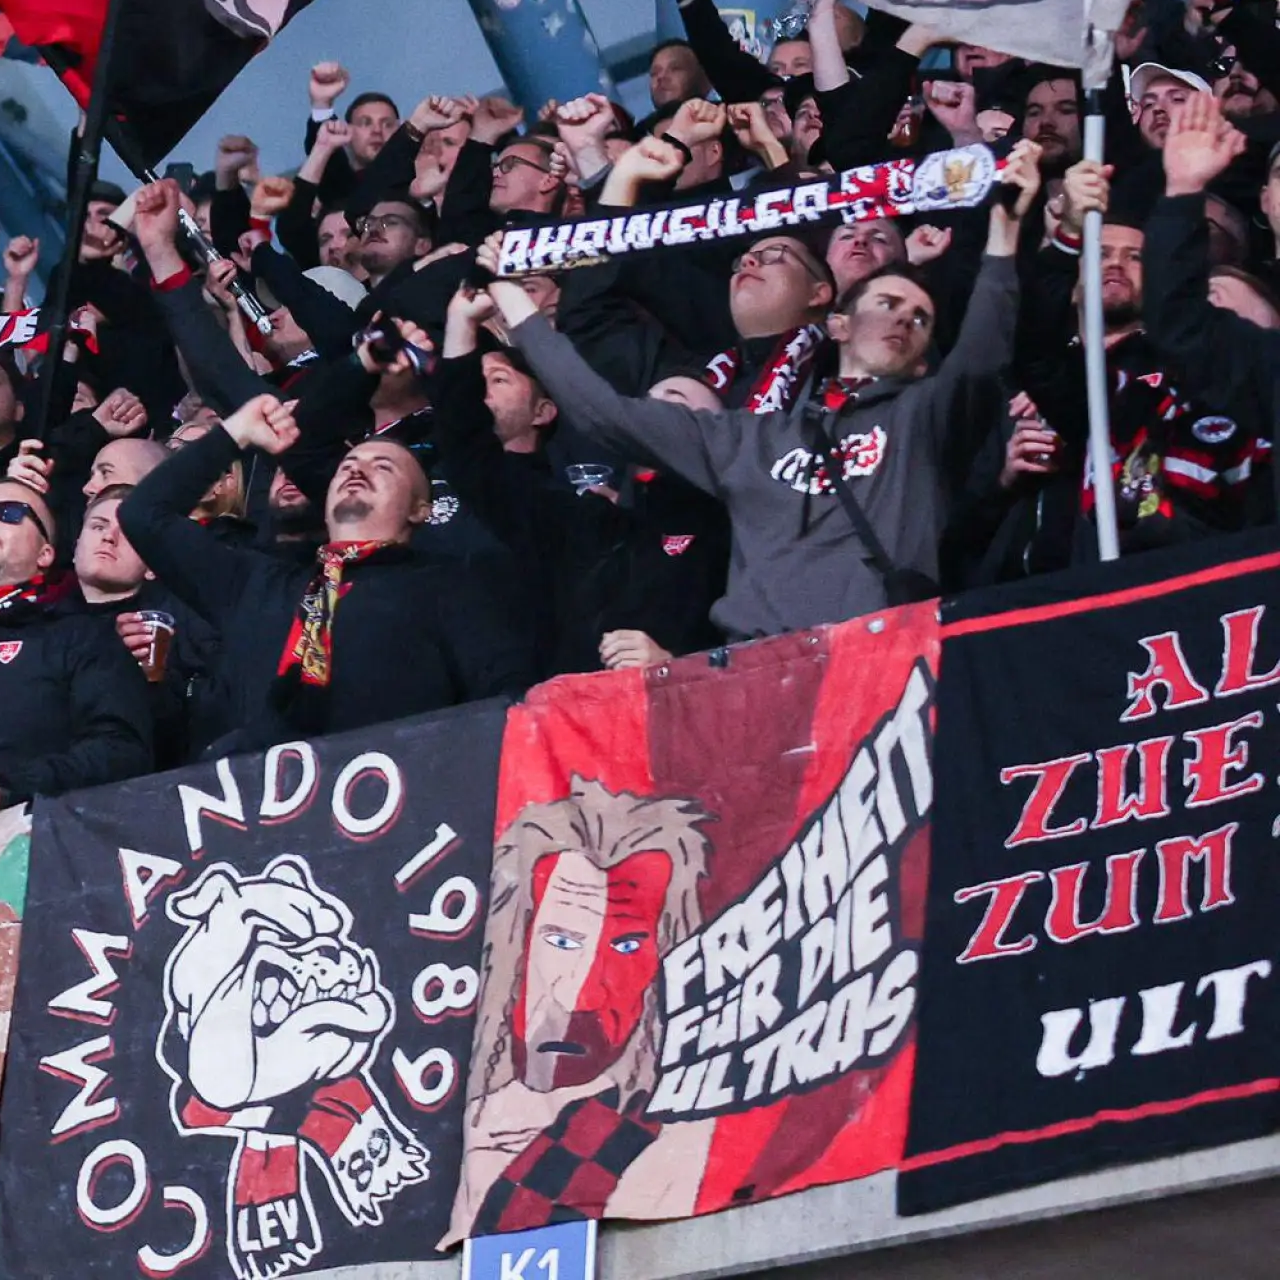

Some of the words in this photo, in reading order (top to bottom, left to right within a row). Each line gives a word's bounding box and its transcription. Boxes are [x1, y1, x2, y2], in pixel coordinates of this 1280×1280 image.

[662, 664, 933, 1007] FREIHEIT
[953, 820, 1238, 965] ZUM
[40, 740, 403, 1278] COMMANDO
[393, 822, 482, 1111] 1989
[647, 950, 918, 1116] ULTRAS
[660, 958, 786, 1068] FÜR
[799, 854, 894, 1007] DIE
[1035, 959, 1272, 1079] ULT
[239, 1199, 301, 1254] LEV
[500, 1247, 560, 1280] K1
